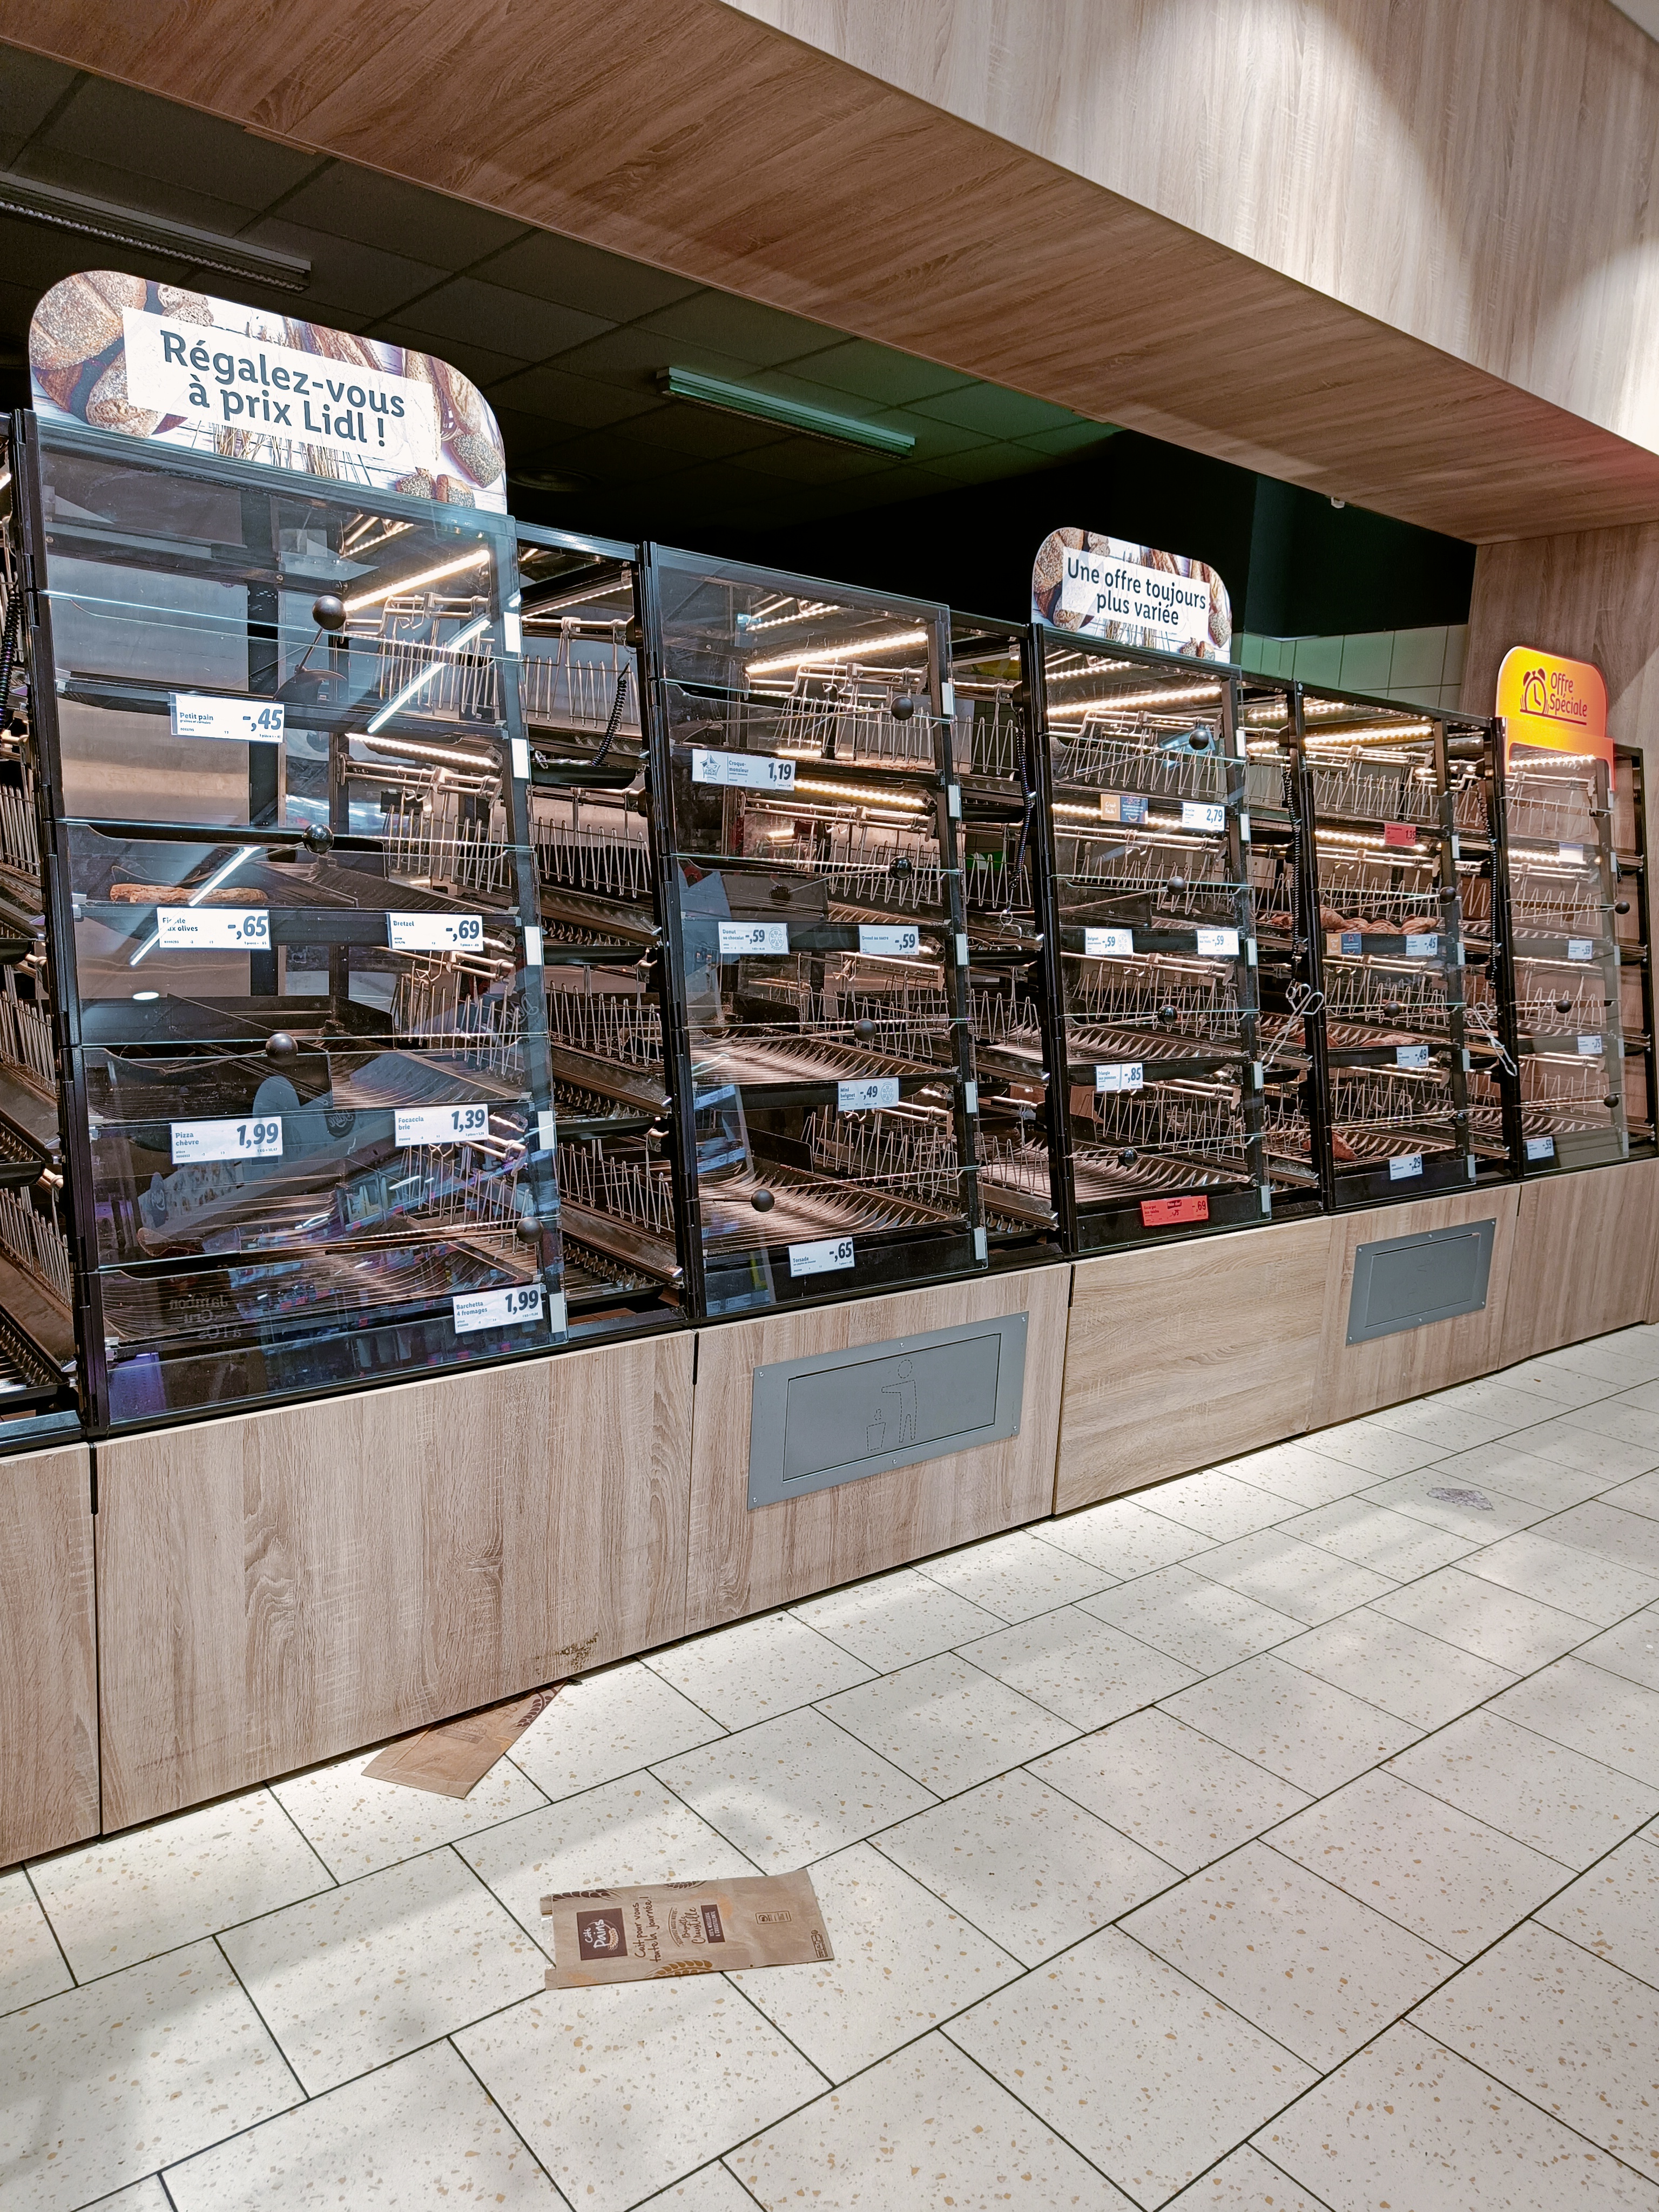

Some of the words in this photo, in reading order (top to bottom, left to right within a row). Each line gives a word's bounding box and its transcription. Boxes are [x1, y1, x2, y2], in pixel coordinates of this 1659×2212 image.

[160, 330, 404, 417] Régalez-vous
[189, 374, 210, 408] à
[220, 389, 292, 426] prix
[304, 401, 367, 443] Lidl
[378, 418, 385, 447] !
[1068, 557, 1100, 583] Une
[1105, 569, 1141, 593] offre
[1146, 579, 1206, 609] toujours
[1097, 590, 1130, 613] plus
[1135, 602, 1178, 625] variée
[1550, 672, 1574, 696] Offre
[1549, 693, 1587, 717] Spéciale
[243, 709, 283, 732] -,45
[768, 762, 792, 782] 1,19
[1206, 808, 1223, 823] 2,79
[228, 916, 268, 940] -,65
[446, 920, 479, 941] -,69
[745, 929, 765, 944] -,59
[895, 933, 915, 950] -,59
[1102, 936, 1115, 948] -,59
[1212, 935, 1224, 946] -,59
[1124, 1067, 1141, 1083] -,85
[860, 1085, 878, 1100] -,49
[451, 1109, 485, 1132] 1,39
[237, 1123, 279, 1149] 1,99
[1192, 1201, 1206, 1212] -,69
[830, 1242, 852, 1262] -,65
[456, 1301, 483, 1310] Barchetta
[462, 1308, 488, 1316] fromages
[505, 1290, 538, 1314] 1,99
[643, 1899, 659, 1930] journée
[583, 1927, 593, 1943] Côté
[594, 1919, 610, 1948] Pains
[635, 1923, 648, 1938] pour
[644, 1932, 657, 1940] la
[678, 1916, 691, 1938] Baguette
[685, 1907, 706, 1944] Croustille
[648, 1941, 662, 1963] toute
